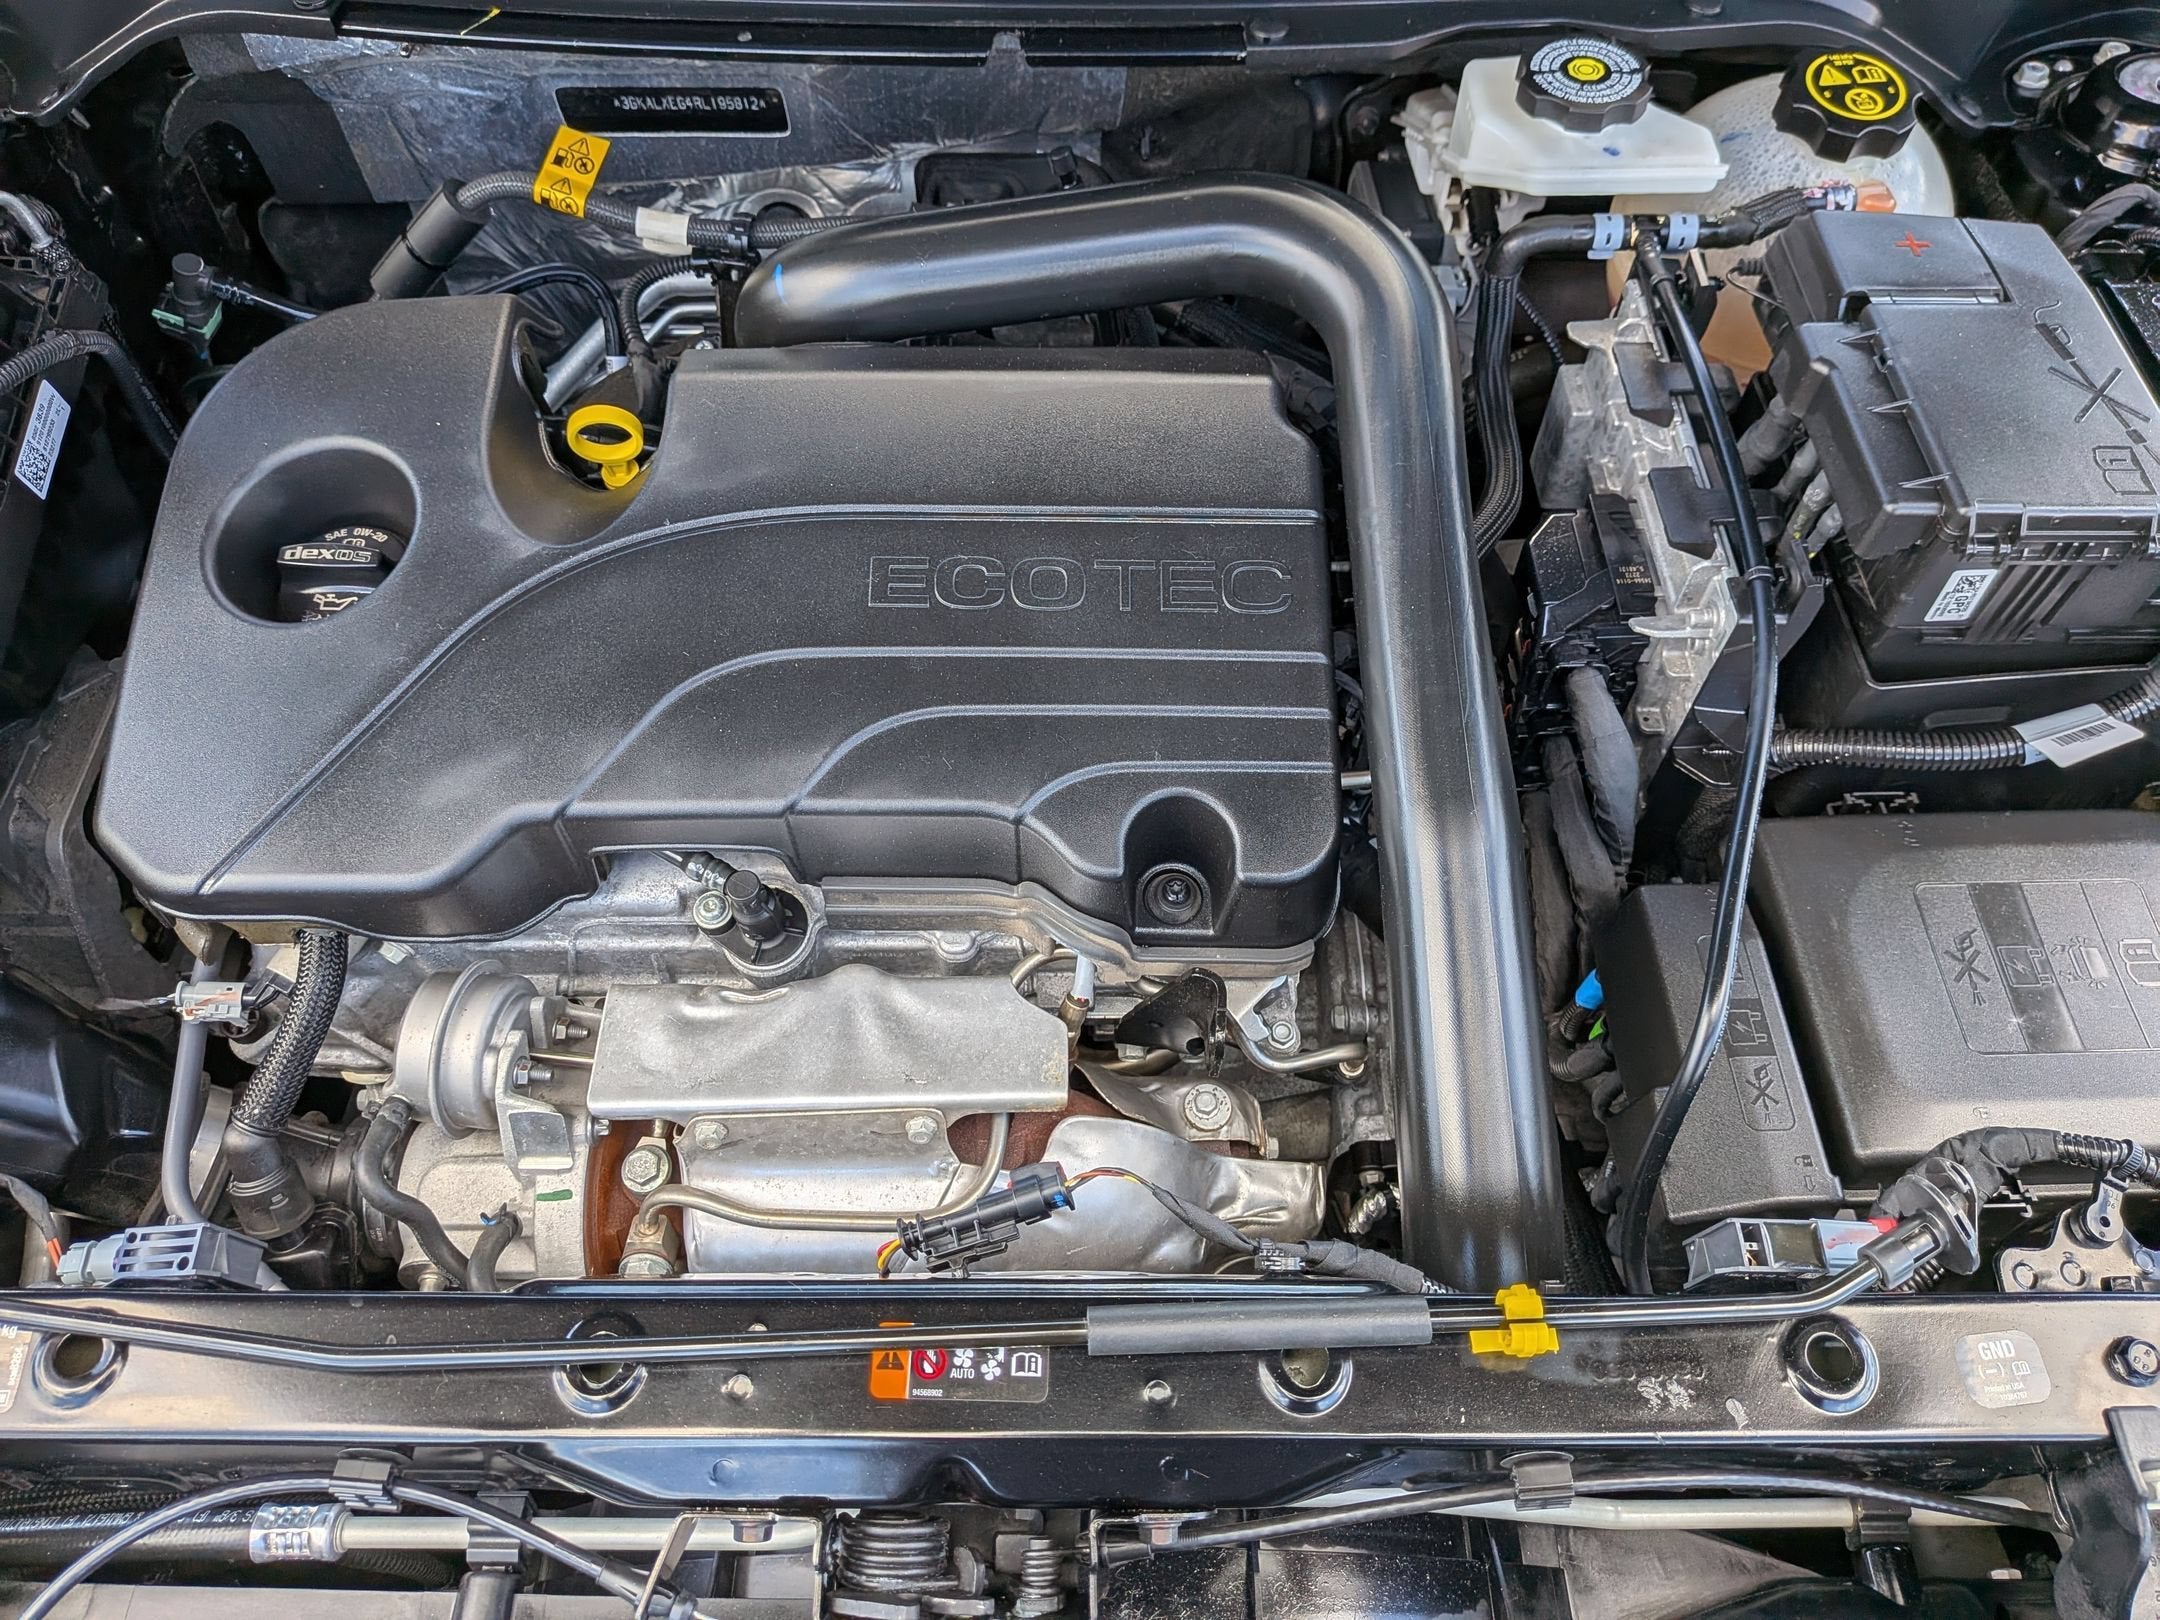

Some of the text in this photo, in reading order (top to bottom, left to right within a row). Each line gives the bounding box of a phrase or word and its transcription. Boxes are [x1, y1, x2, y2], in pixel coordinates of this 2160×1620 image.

[324, 527, 388, 542] SAE 0W-20
[284, 546, 372, 563] dexos
[868, 555, 1293, 615] ECOTEC
[1947, 595, 1969, 614] GPC
[1977, 1339, 2016, 1361] GND
[950, 1368, 975, 1379] AUTO
[912, 1388, 943, 1397] 94568902
[2011, 1381, 2025, 1390] USA
